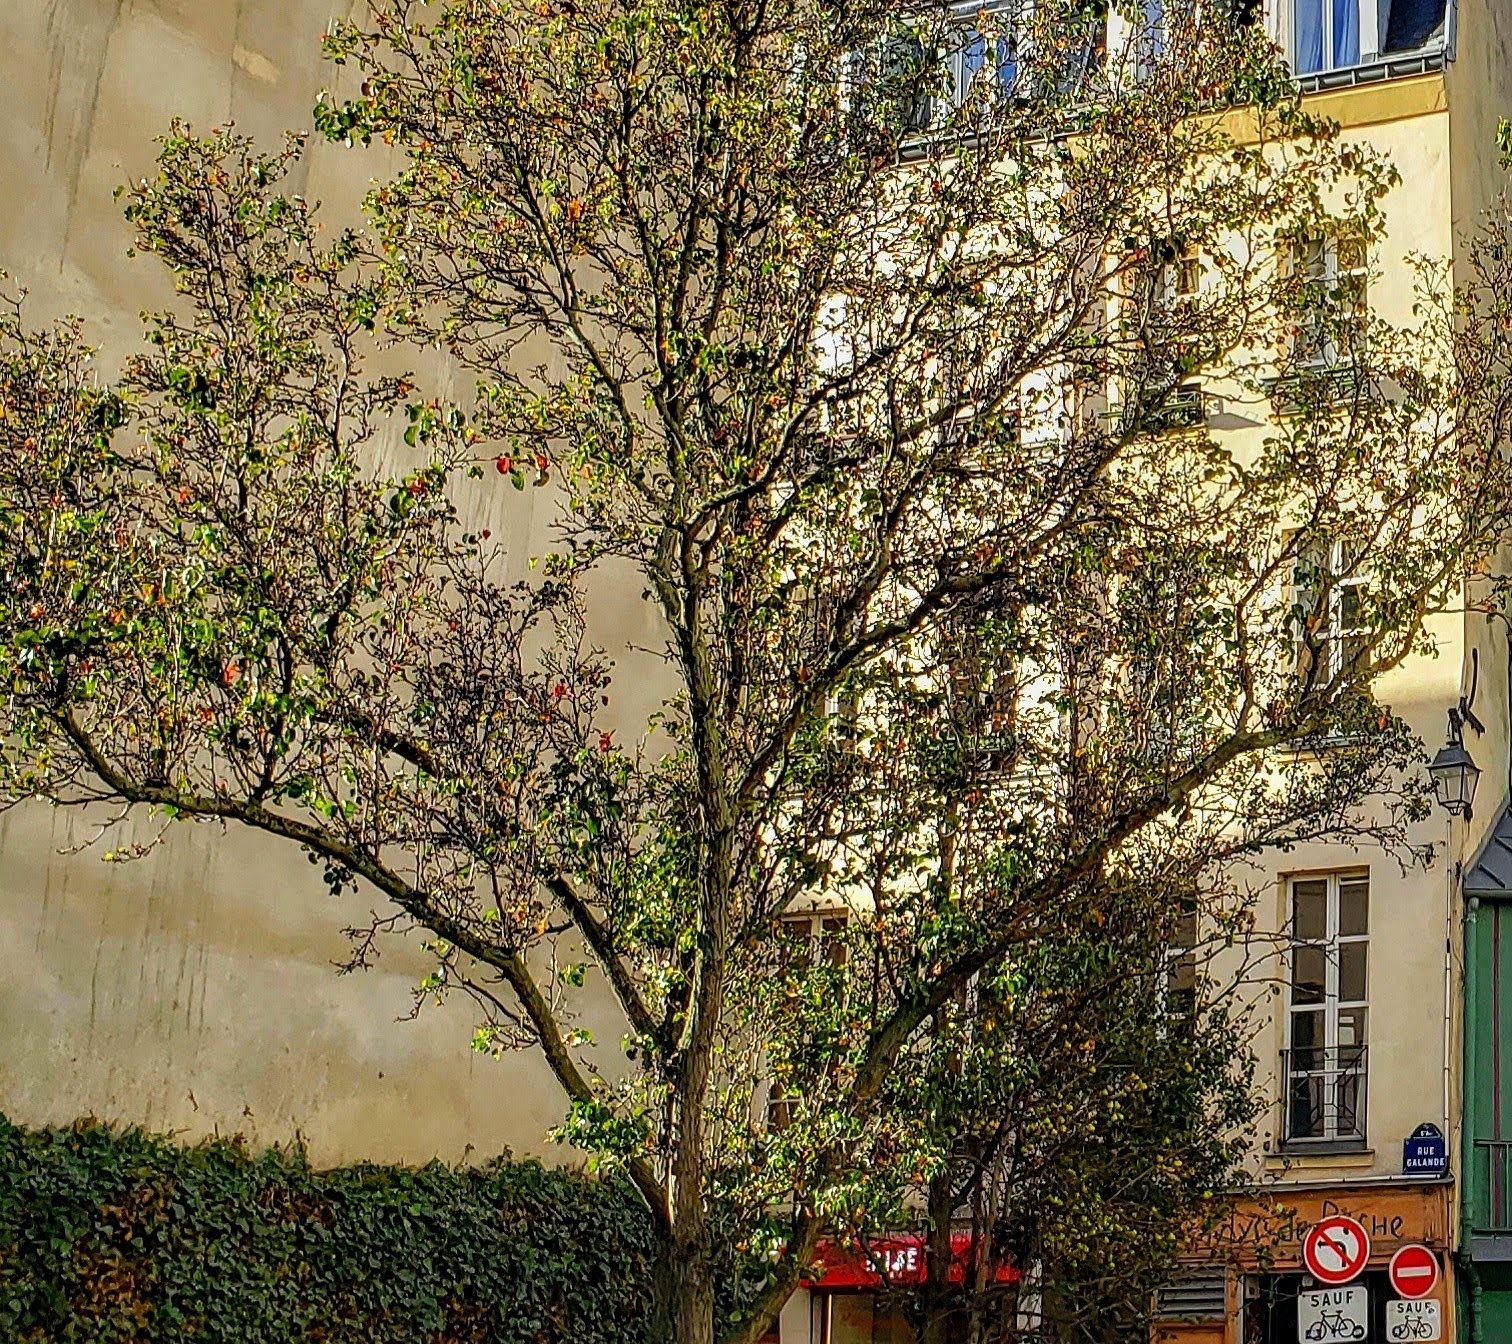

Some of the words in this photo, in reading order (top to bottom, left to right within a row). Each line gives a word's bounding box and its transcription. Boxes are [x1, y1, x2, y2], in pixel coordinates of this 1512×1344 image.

[1417, 1146, 1435, 1156] RUE
[1406, 1157, 1445, 1168] GALANDE
[1310, 1290, 1354, 1307] SAUF
